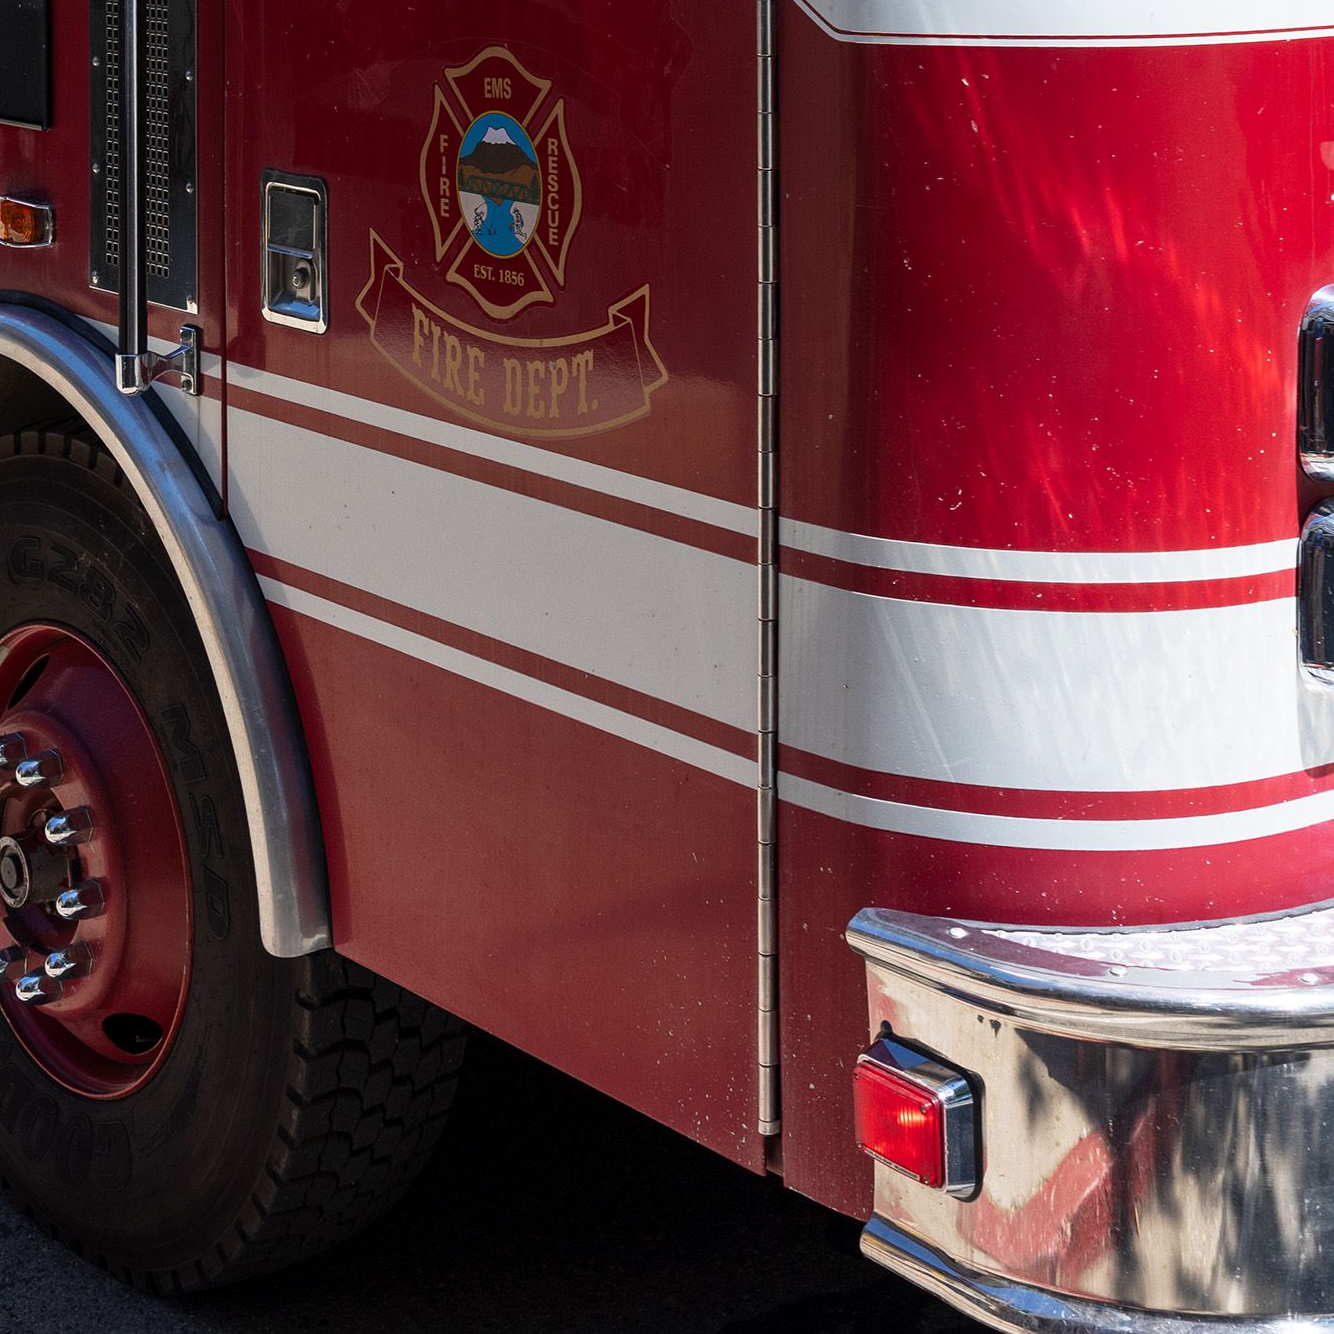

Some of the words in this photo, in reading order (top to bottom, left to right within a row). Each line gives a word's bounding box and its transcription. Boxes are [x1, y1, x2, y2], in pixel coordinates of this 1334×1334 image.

[483, 77, 512, 99] EMS
[439, 134, 451, 218] FIRE
[546, 137, 560, 246] RESCUE
[473, 264, 496, 282] EST.
[499, 268, 526, 286] 1856
[411, 302, 486, 408] FIRE
[502, 349, 600, 420] DEPT.
[8, 536, 152, 668] G282
